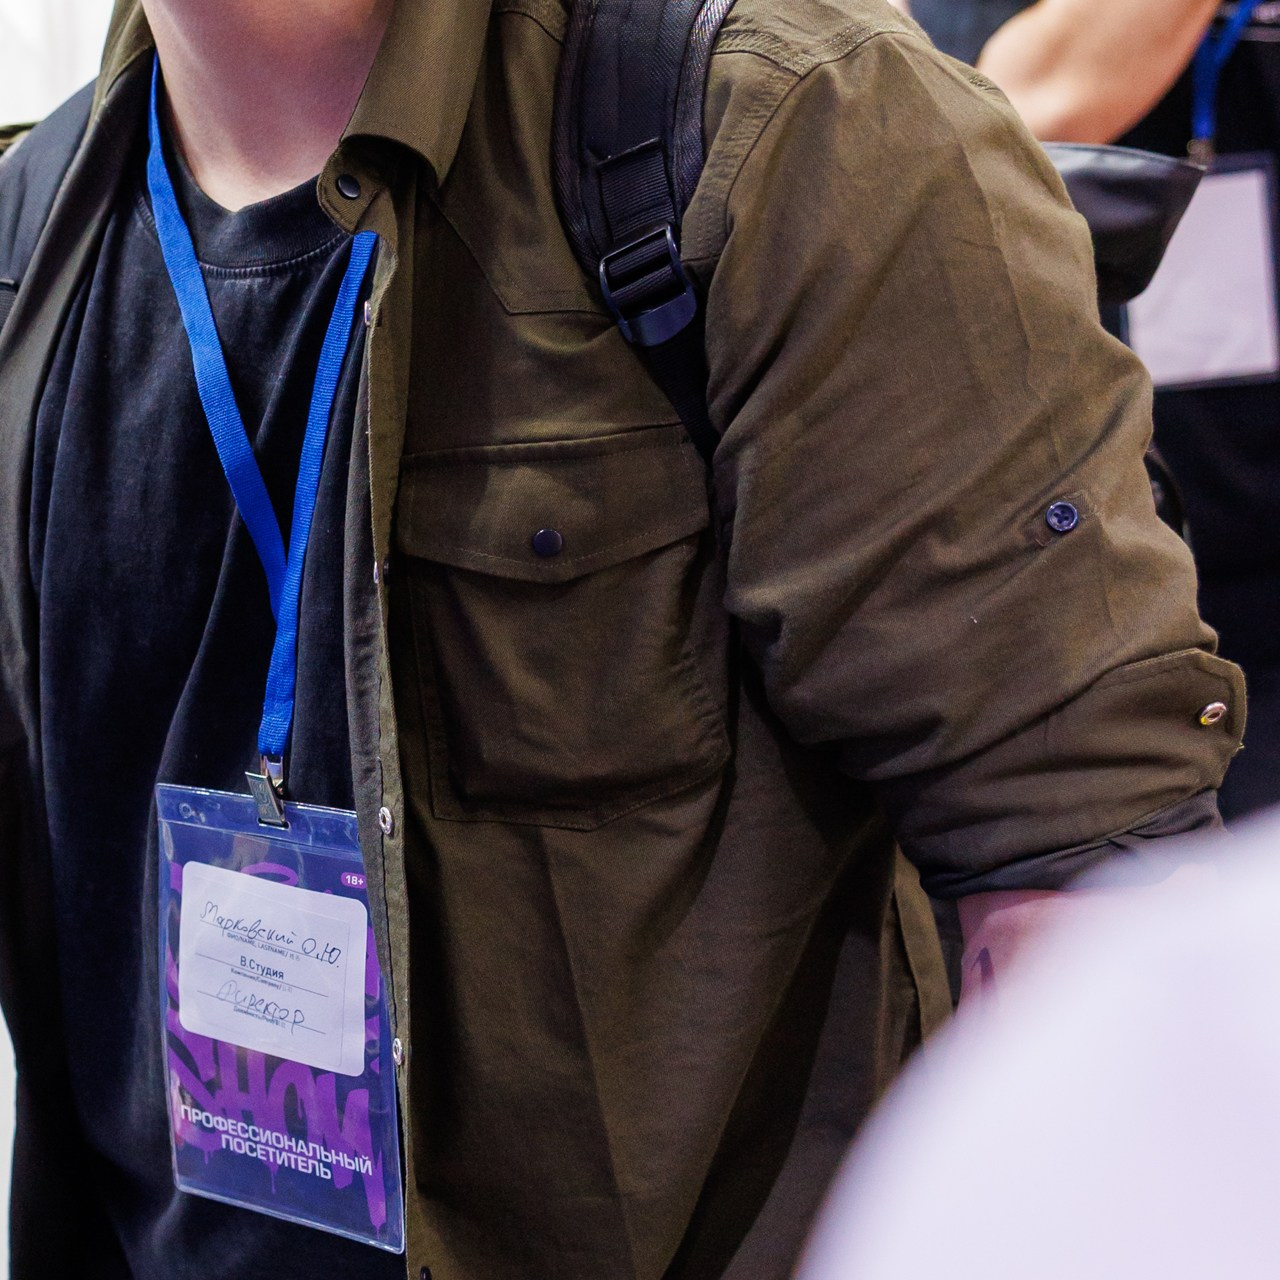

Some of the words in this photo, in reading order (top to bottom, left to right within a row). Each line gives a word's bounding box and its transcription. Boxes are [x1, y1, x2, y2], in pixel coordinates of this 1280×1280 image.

[345, 874, 365, 886] 18+
[240, 955, 285, 980] В.Студия
[180, 1104, 374, 1176] ПРОФЕССИОНАЛЬНЫЙ
[221, 1134, 333, 1180] ПОСЕТИТЕЛЬ
